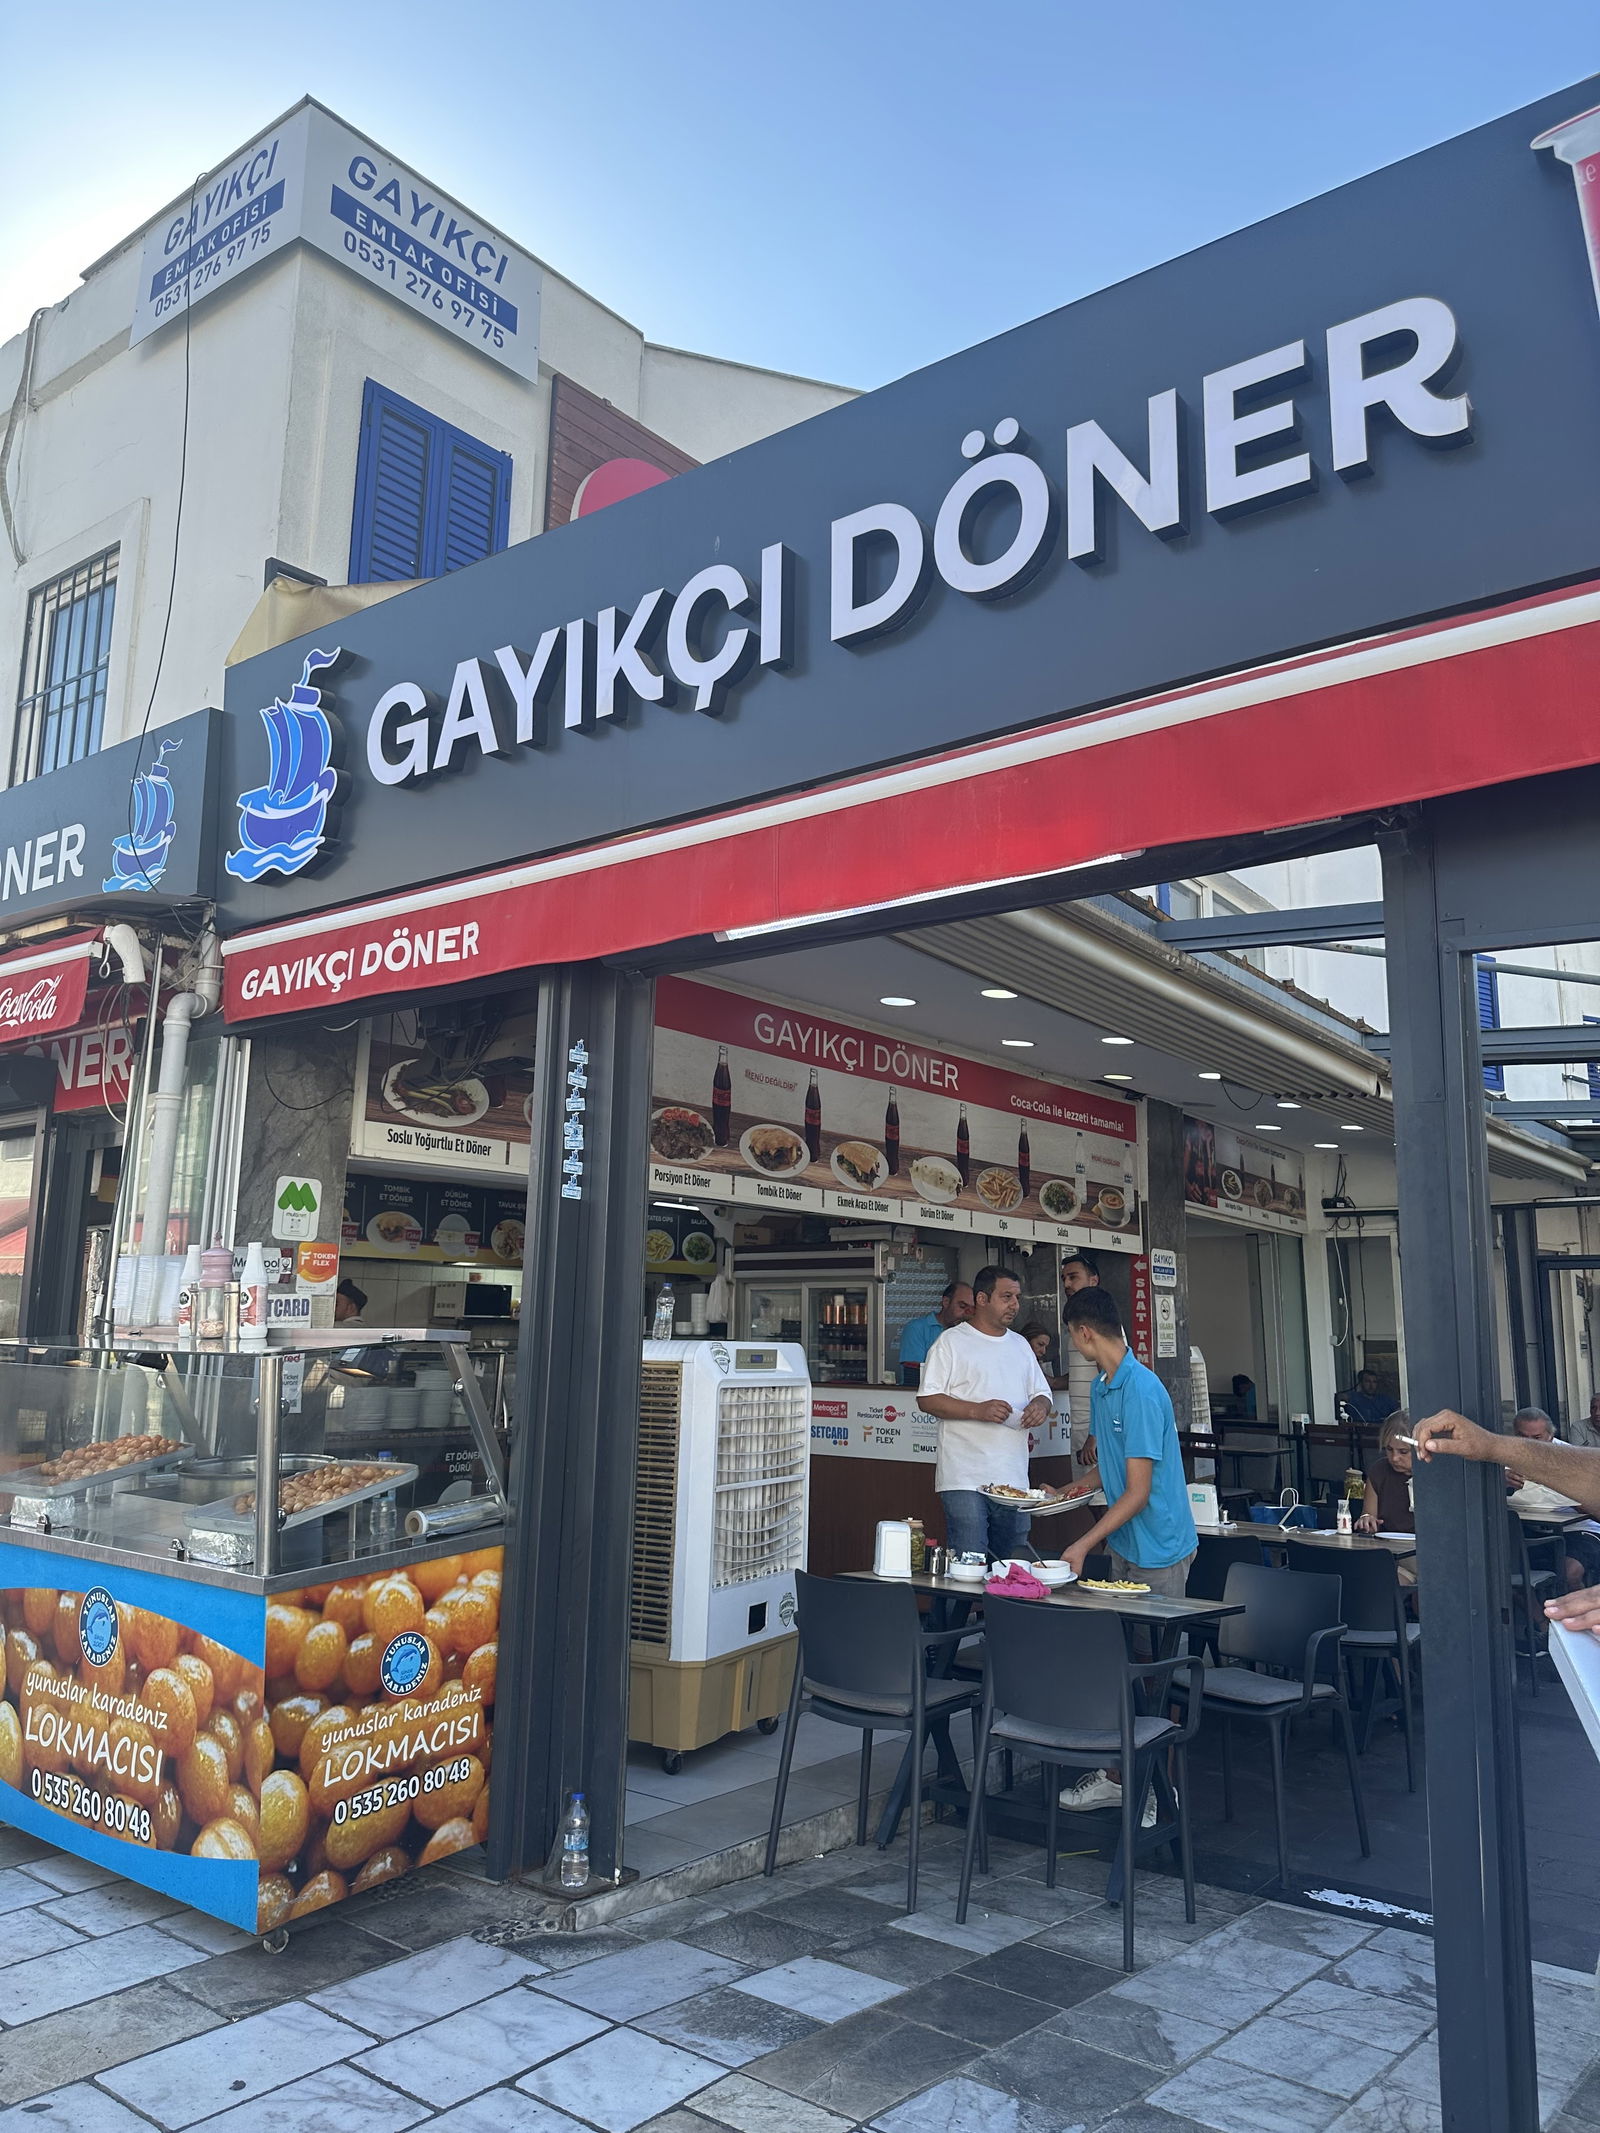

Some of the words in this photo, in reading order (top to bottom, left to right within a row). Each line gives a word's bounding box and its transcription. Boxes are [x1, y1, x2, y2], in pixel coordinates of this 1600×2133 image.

[164, 140, 279, 255] GAYIKÇI
[348, 156, 508, 284] GAYIKÇI
[165, 235, 216, 286] EMLAK
[221, 195, 267, 242] OFİSİ
[356, 209, 433, 273] EMLAK
[442, 267, 497, 316] OFİSİ
[155, 279, 188, 317] 0531
[194, 256, 221, 290] 276
[227, 238, 246, 266] 97
[252, 222, 271, 250] 75
[344, 231, 396, 280] 0531
[405, 270, 443, 309] 276
[451, 301, 475, 327] 97
[482, 318, 504, 348] 75
[366, 541, 790, 787] GAYIKÇI
[830, 296, 1473, 644] DÖNER
[0, 823, 86, 901] NER
[241, 948, 354, 1000] GAYIKÇI
[360, 921, 480, 977] DÖNER
[754, 1013, 864, 1072] GAYIKÇI
[874, 1043, 959, 1091] DÖNER
[1010, 1095, 1051, 1115] Coca-Cola
[1052, 1105, 1063, 1117] ile
[1064, 1108, 1089, 1124] lezzeti
[1091, 1115, 1124, 1132] tamamla!
[387, 1128, 412, 1145] Soslu
[415, 1132, 453, 1151] Yoğurtlu
[455, 1139, 465, 1153] Et
[466, 1140, 492, 1156] Döner
[654, 1169, 684, 1186] Porsiyon
[684, 1173, 692, 1185] Et
[692, 1174, 711, 1188] Döner
[757, 1184, 778, 1198] Tombik
[778, 1187, 786, 1199] Et
[786, 1188, 802, 1201] Döner
[837, 1196, 855, 1209] Ekmek
[868, 1201, 874, 1211] Et
[874, 1201, 889, 1213] Döner
[920, 1207, 935, 1219] Dürüm
[936, 1210, 941, 1220] Et
[941, 1210, 954, 1221] Döner
[313, 1252, 337, 1260] TOKEN
[313, 1259, 330, 1267] FLEX
[1135, 1278, 1147, 1322] SAAT
[811, 1425, 849, 1440] SETCARD
[813, 1402, 840, 1413] Metropol
[876, 1428, 901, 1436] TOKEN
[445, 1452, 455, 1461] ET
[876, 1436, 894, 1445] FLEX
[83, 1591, 116, 1625] YUNUSLAR
[385, 1636, 426, 1663] YUNUSLAR
[26, 1671, 88, 1705] yunuslar
[92, 1682, 168, 1730] karadeniz
[321, 1712, 398, 1753] yunuslar
[403, 1684, 482, 1722] karadeniz
[26, 1706, 163, 1787] LOKMACISI
[324, 1713, 479, 1788] LOKMACISI
[31, 1768, 41, 1798] 0
[44, 1772, 70, 1809] 535
[72, 1783, 101, 1823] 260
[104, 1796, 127, 1833] 80
[128, 1805, 150, 1842] 48
[334, 1800, 347, 1824] 0
[351, 1787, 383, 1819] 535
[386, 1774, 420, 1808] 260
[423, 1766, 446, 1794] 80
[448, 1758, 471, 1783] 48
